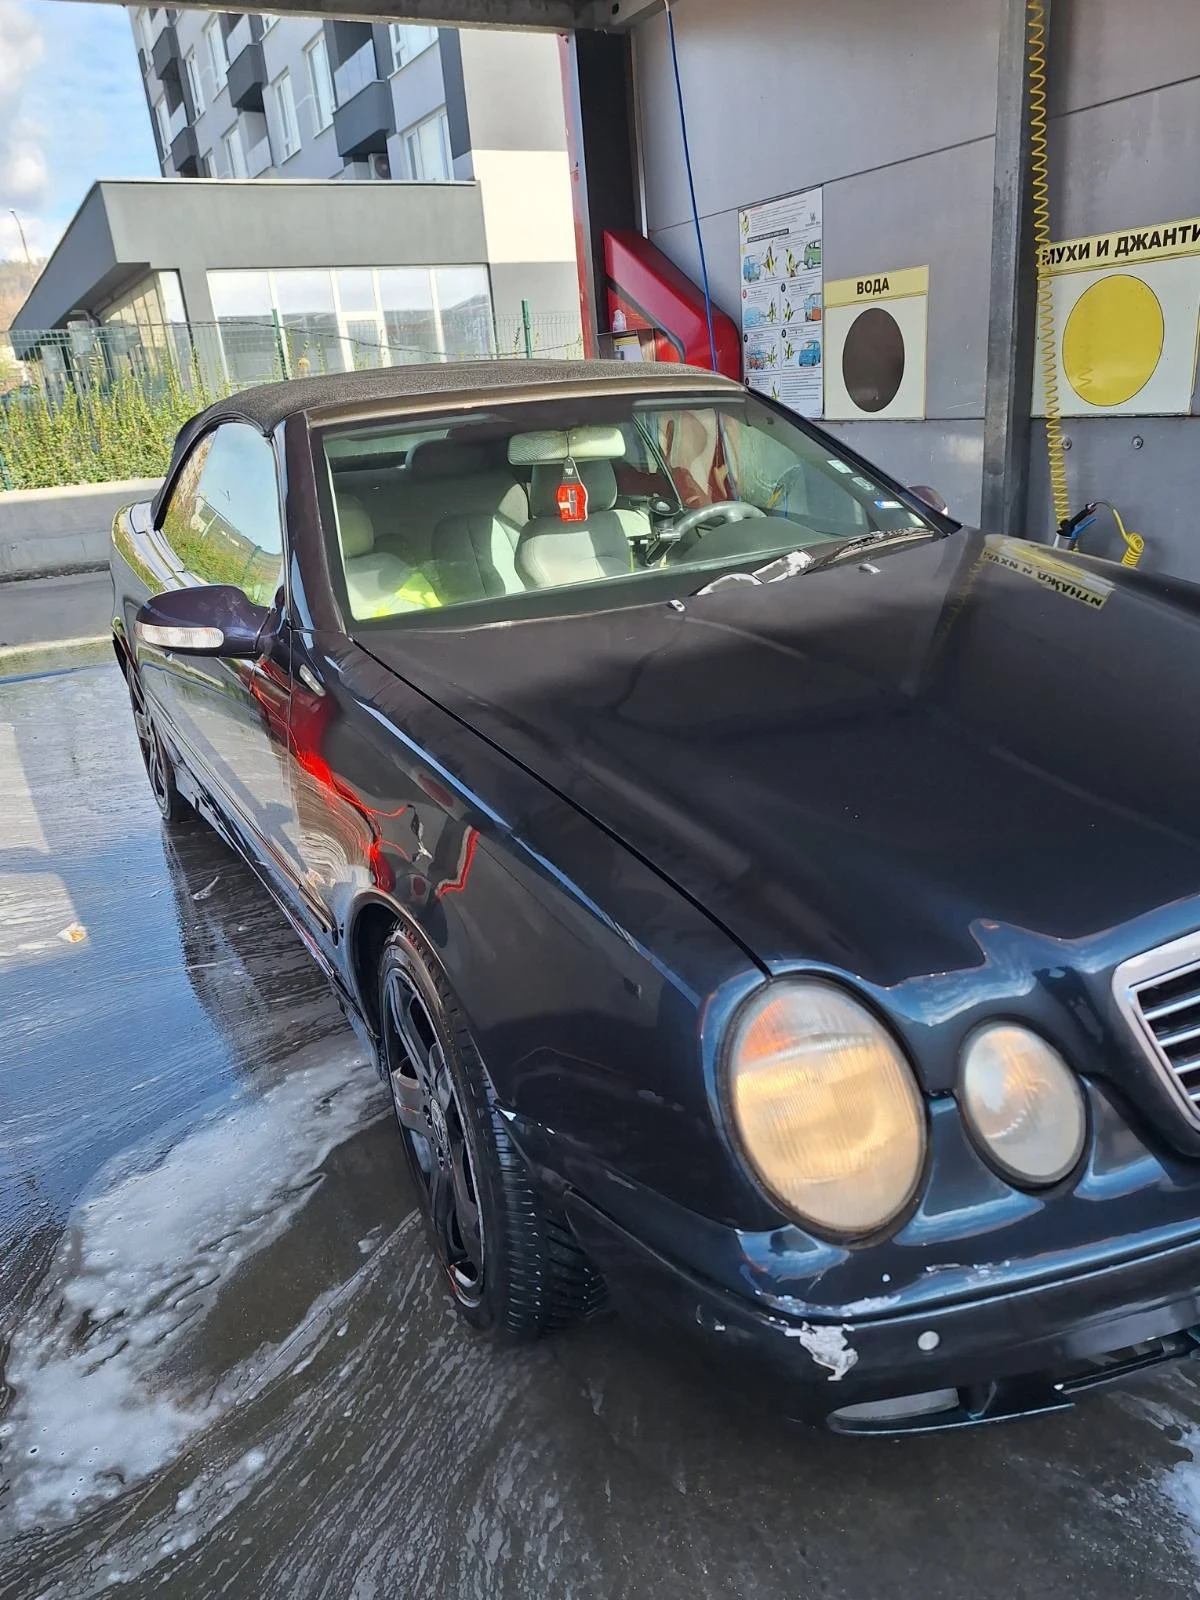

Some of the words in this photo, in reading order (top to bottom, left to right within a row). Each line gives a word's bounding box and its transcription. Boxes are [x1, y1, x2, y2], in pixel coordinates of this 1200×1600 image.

[1042, 242, 1090, 266] МУХИ
[1096, 239, 1110, 257] И
[1114, 223, 1200, 258] ДЖАНТИ
[856, 277, 890, 296] ВОДА
